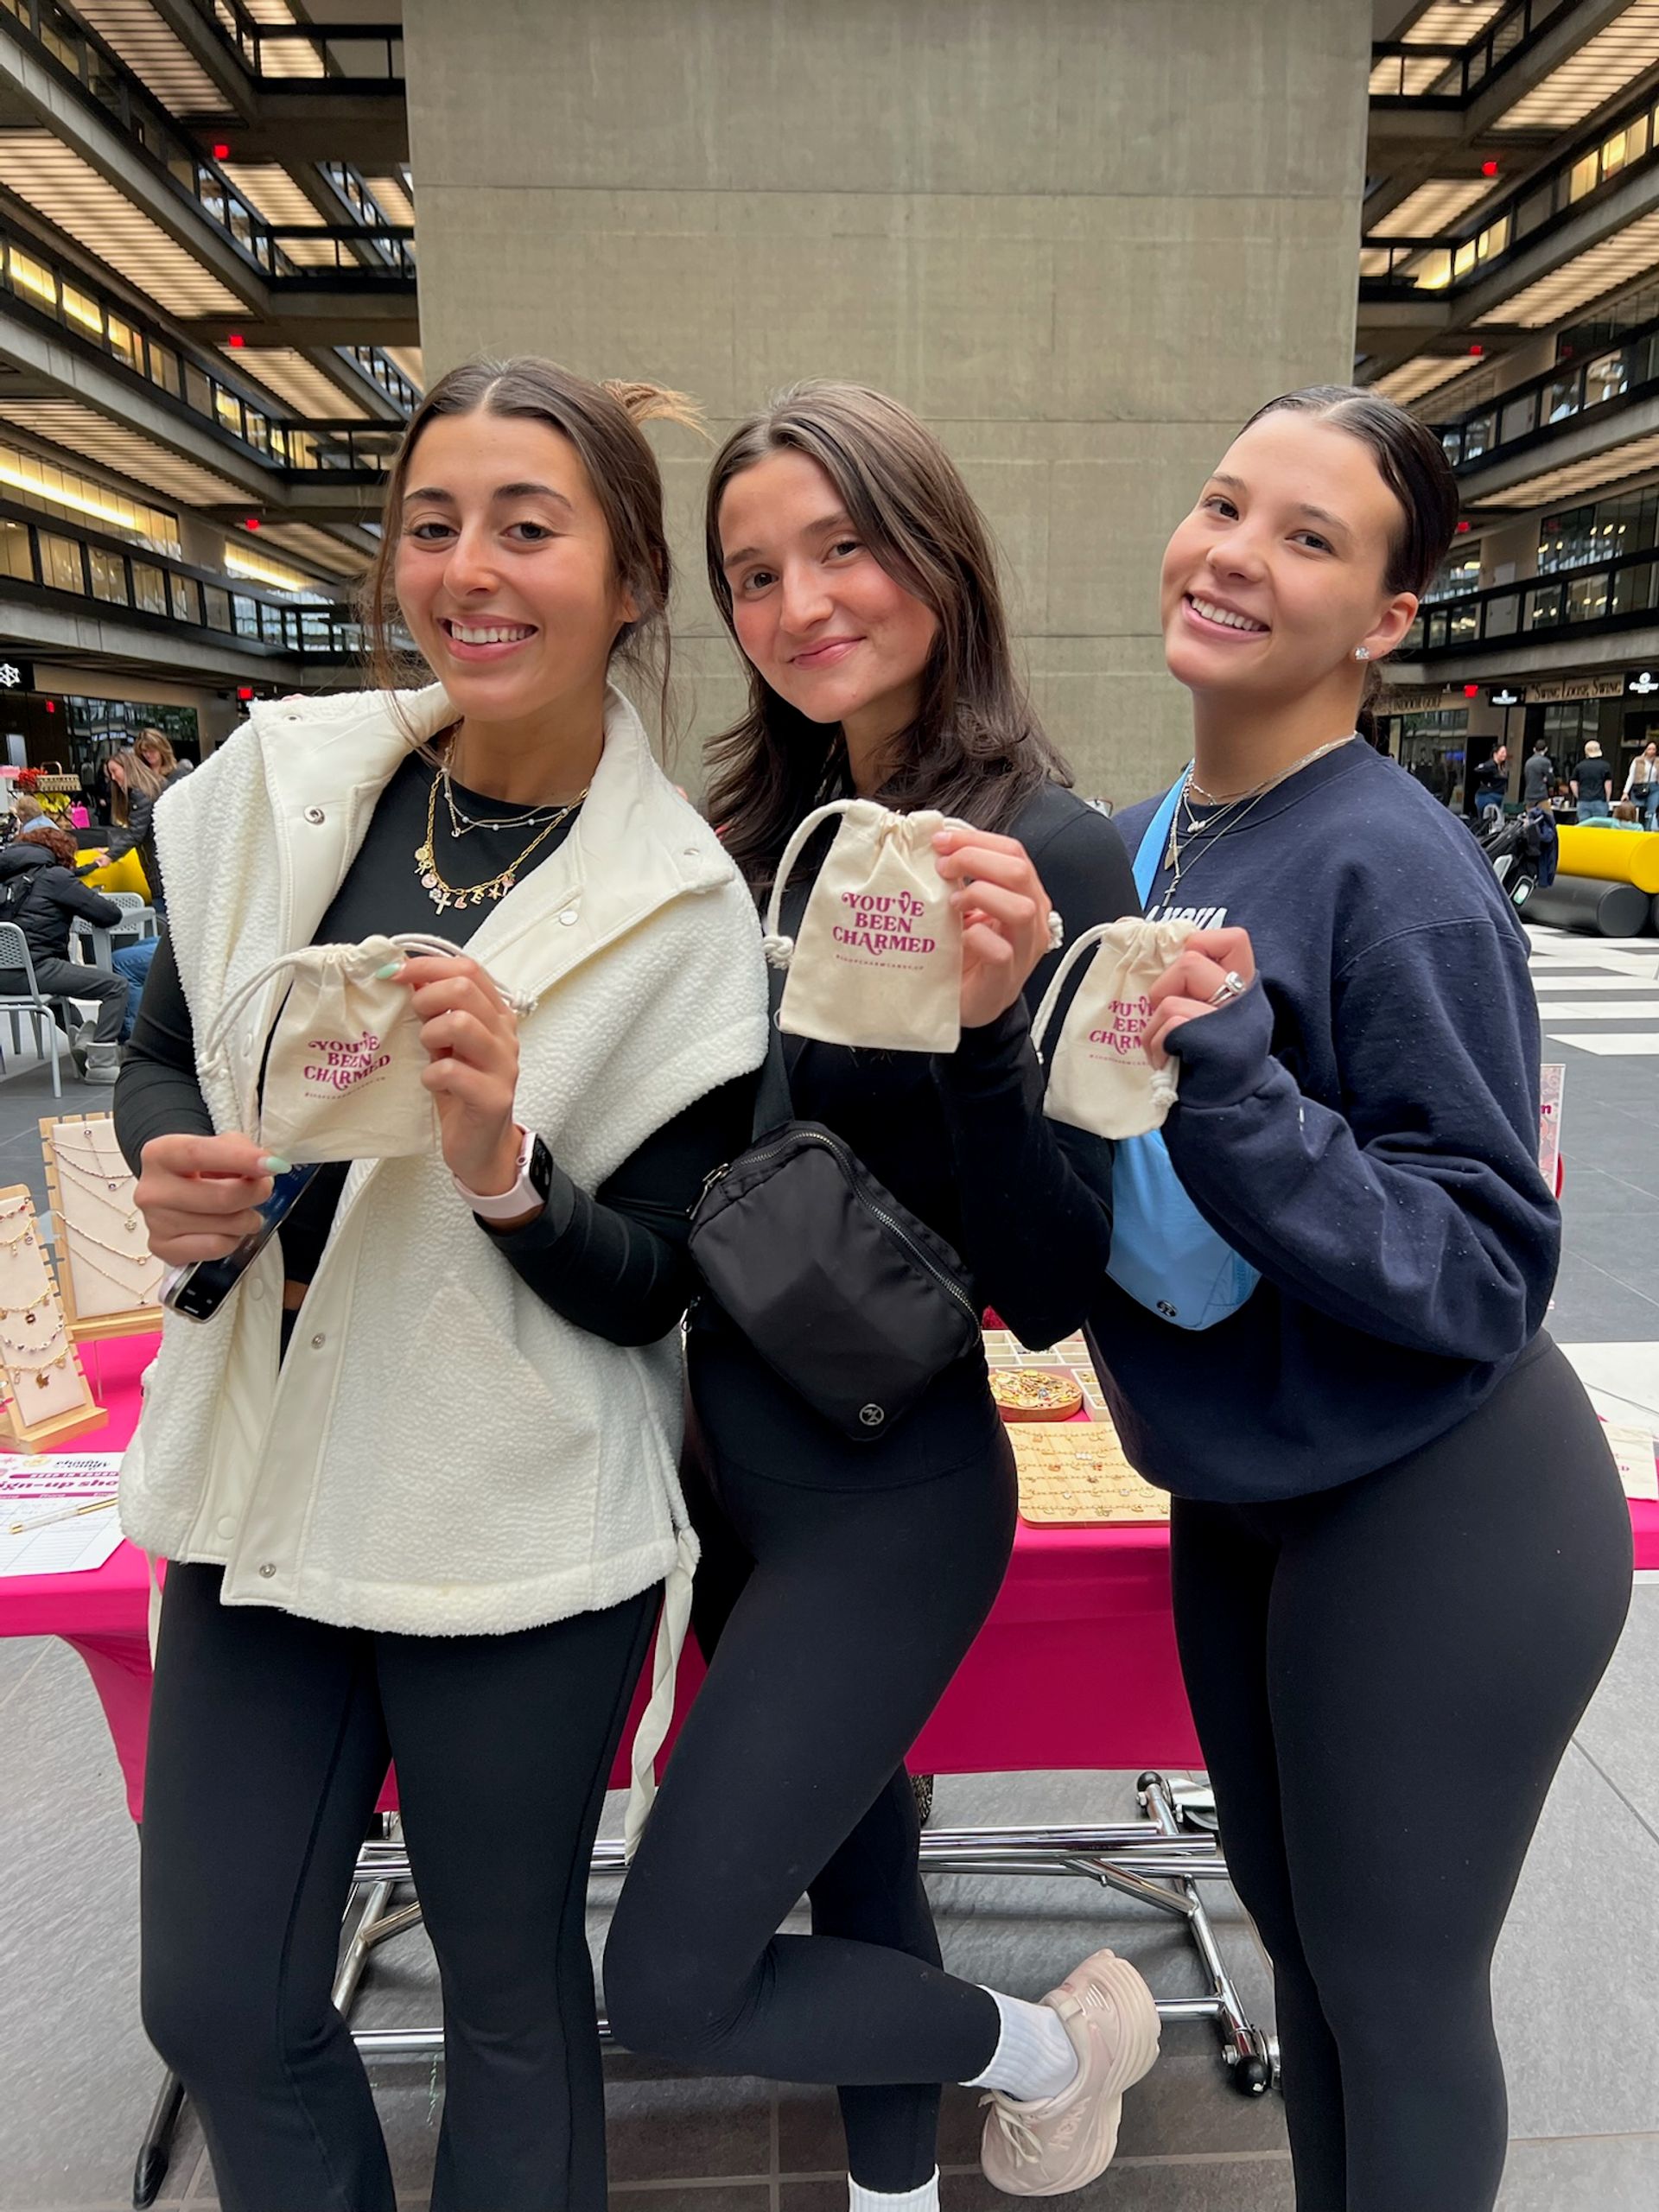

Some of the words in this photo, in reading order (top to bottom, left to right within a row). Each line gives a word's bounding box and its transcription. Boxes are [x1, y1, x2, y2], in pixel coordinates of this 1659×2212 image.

[842, 891, 925, 917] YOU'VE
[855, 912, 912, 933] BEEN
[833, 925, 936, 956] CHARMED
[1108, 995, 1154, 1017] YU'V
[1113, 1016, 1147, 1033] EEN
[327, 1052, 372, 1068] BEEN
[303, 1054, 391, 1090] CHARMED
[0, 1480, 74, 1491] ign-up
